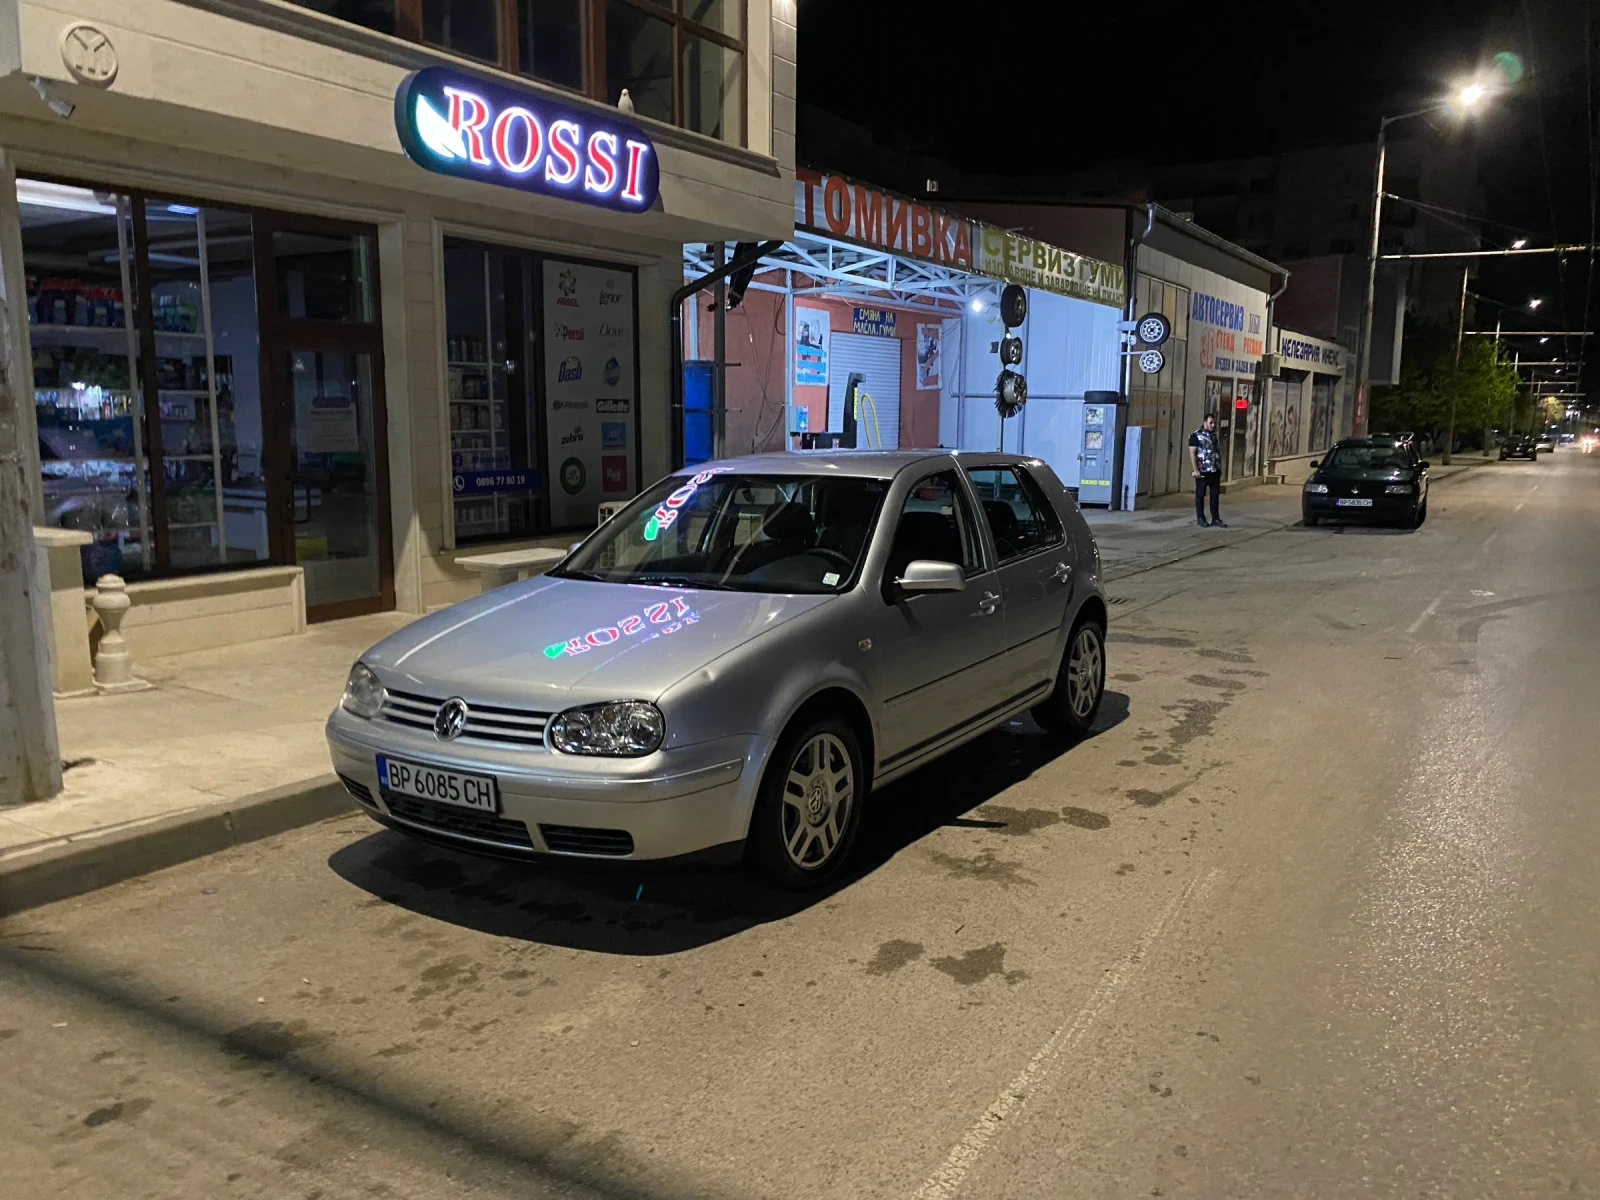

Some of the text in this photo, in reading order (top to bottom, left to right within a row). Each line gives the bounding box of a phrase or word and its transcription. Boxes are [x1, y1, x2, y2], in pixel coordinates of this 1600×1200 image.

[443, 86, 647, 201] ROSSI
[796, 167, 972, 270] ТОМИВКА
[983, 229, 1125, 291] СЕРВИЗ ГУМИ
[984, 258, 1036, 284] ИЗПАВЯНЕ
[556, 297, 580, 308] ARIEL
[599, 289, 622, 306] Lenor
[859, 308, 894, 323] СМЯНА НА
[1192, 292, 1245, 332] АВТОСЕРВИЗ
[562, 325, 584, 341] Persil
[599, 322, 624, 338] Dove
[558, 360, 583, 383] Dash
[553, 400, 588, 411] GARNIER
[597, 400, 629, 413] Gillette
[476, 475, 525, 487] 0896 77 80 19
[389, 763, 491, 807] BP 6085 CH
